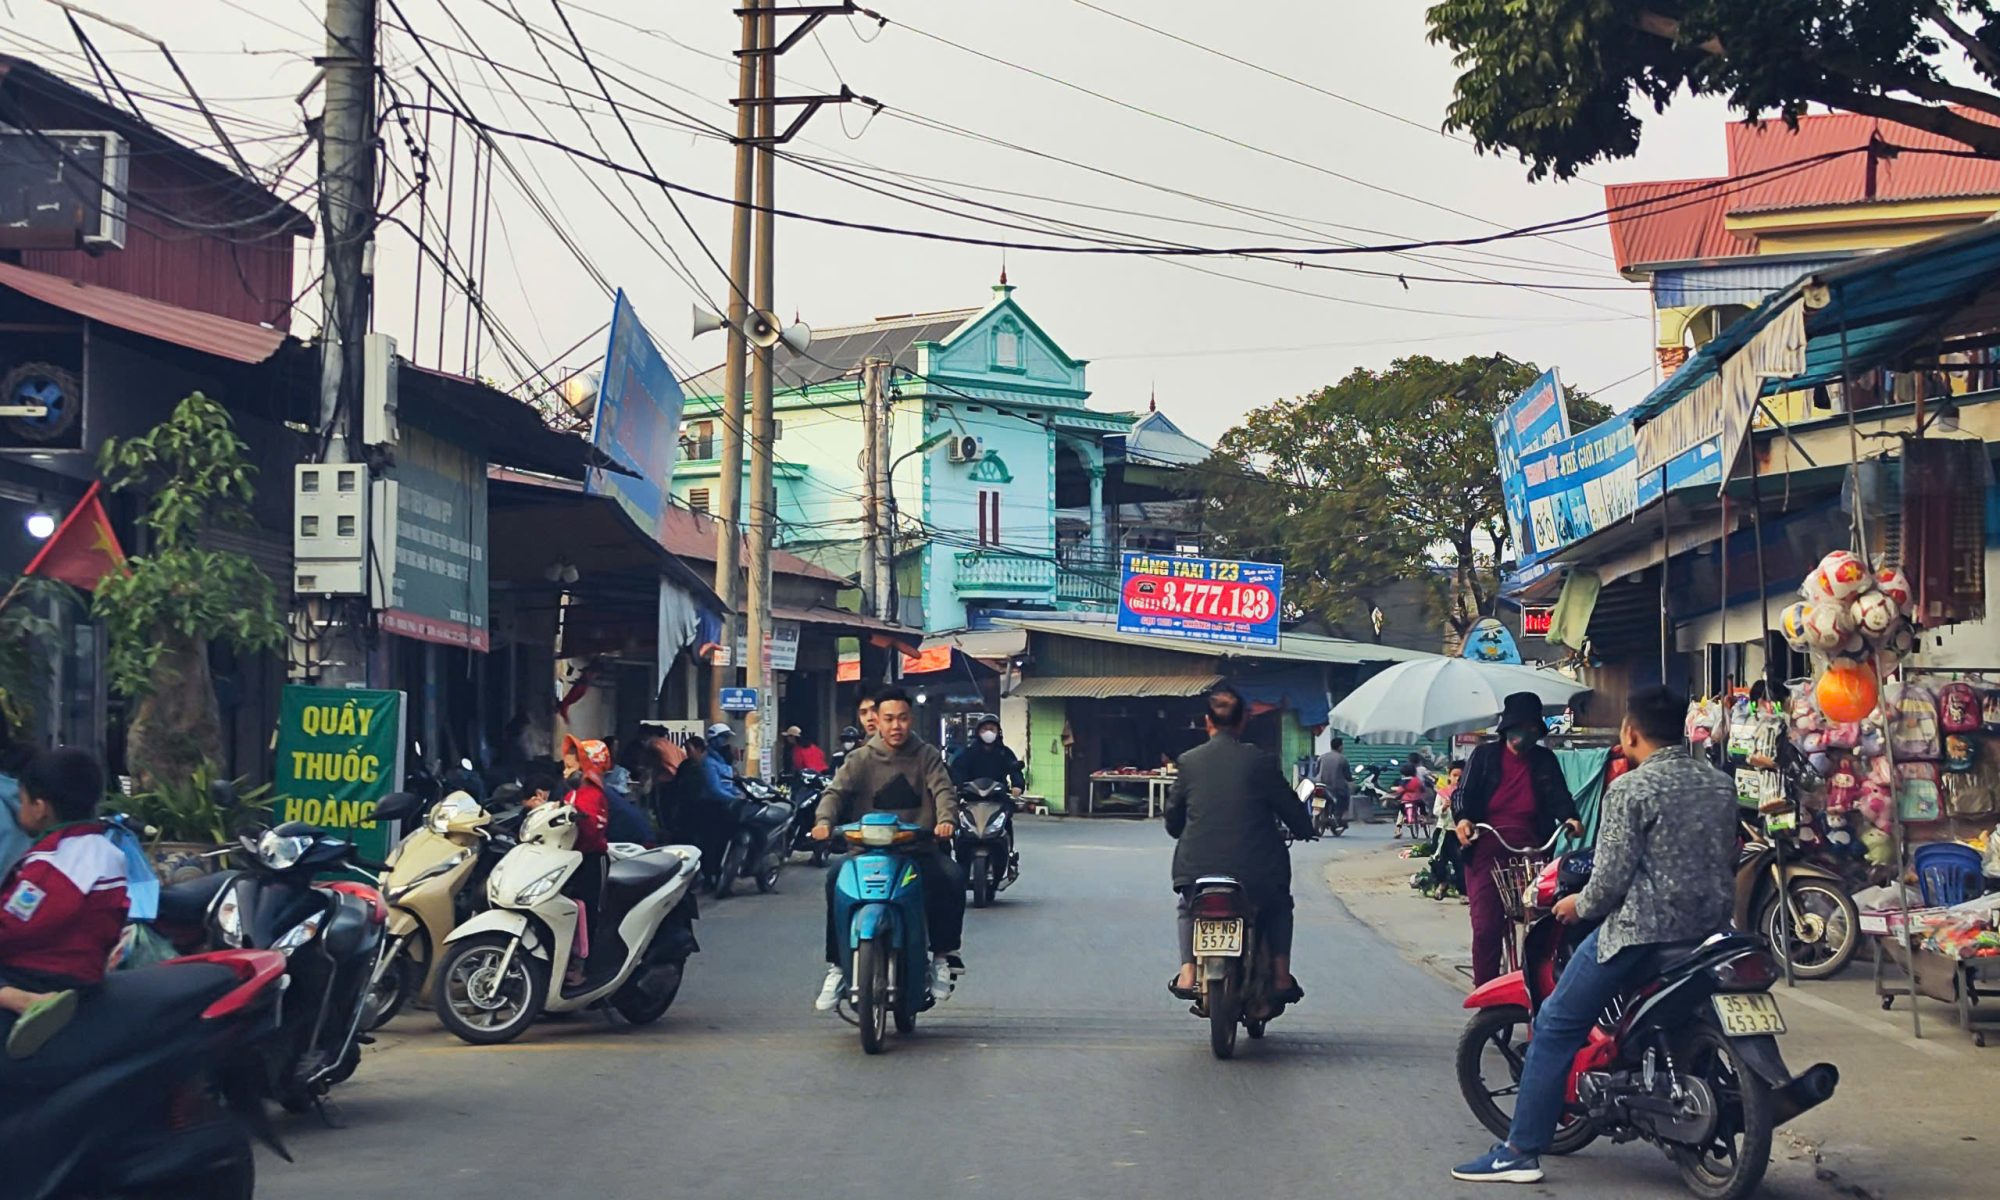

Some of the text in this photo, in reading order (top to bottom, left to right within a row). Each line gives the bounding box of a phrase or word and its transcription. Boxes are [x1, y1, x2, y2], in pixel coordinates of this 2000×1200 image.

[1130, 556, 1169, 576] HÃNG
[1173, 561, 1204, 579] TAXI
[1209, 563, 1239, 581] 123
[1162, 581, 1270, 620] 3.777.123
[302, 698, 374, 737] QUẦY
[292, 745, 379, 783] THUỐC
[284, 794, 377, 830] HOÀNG
[1201, 935, 1235, 949] 5572
